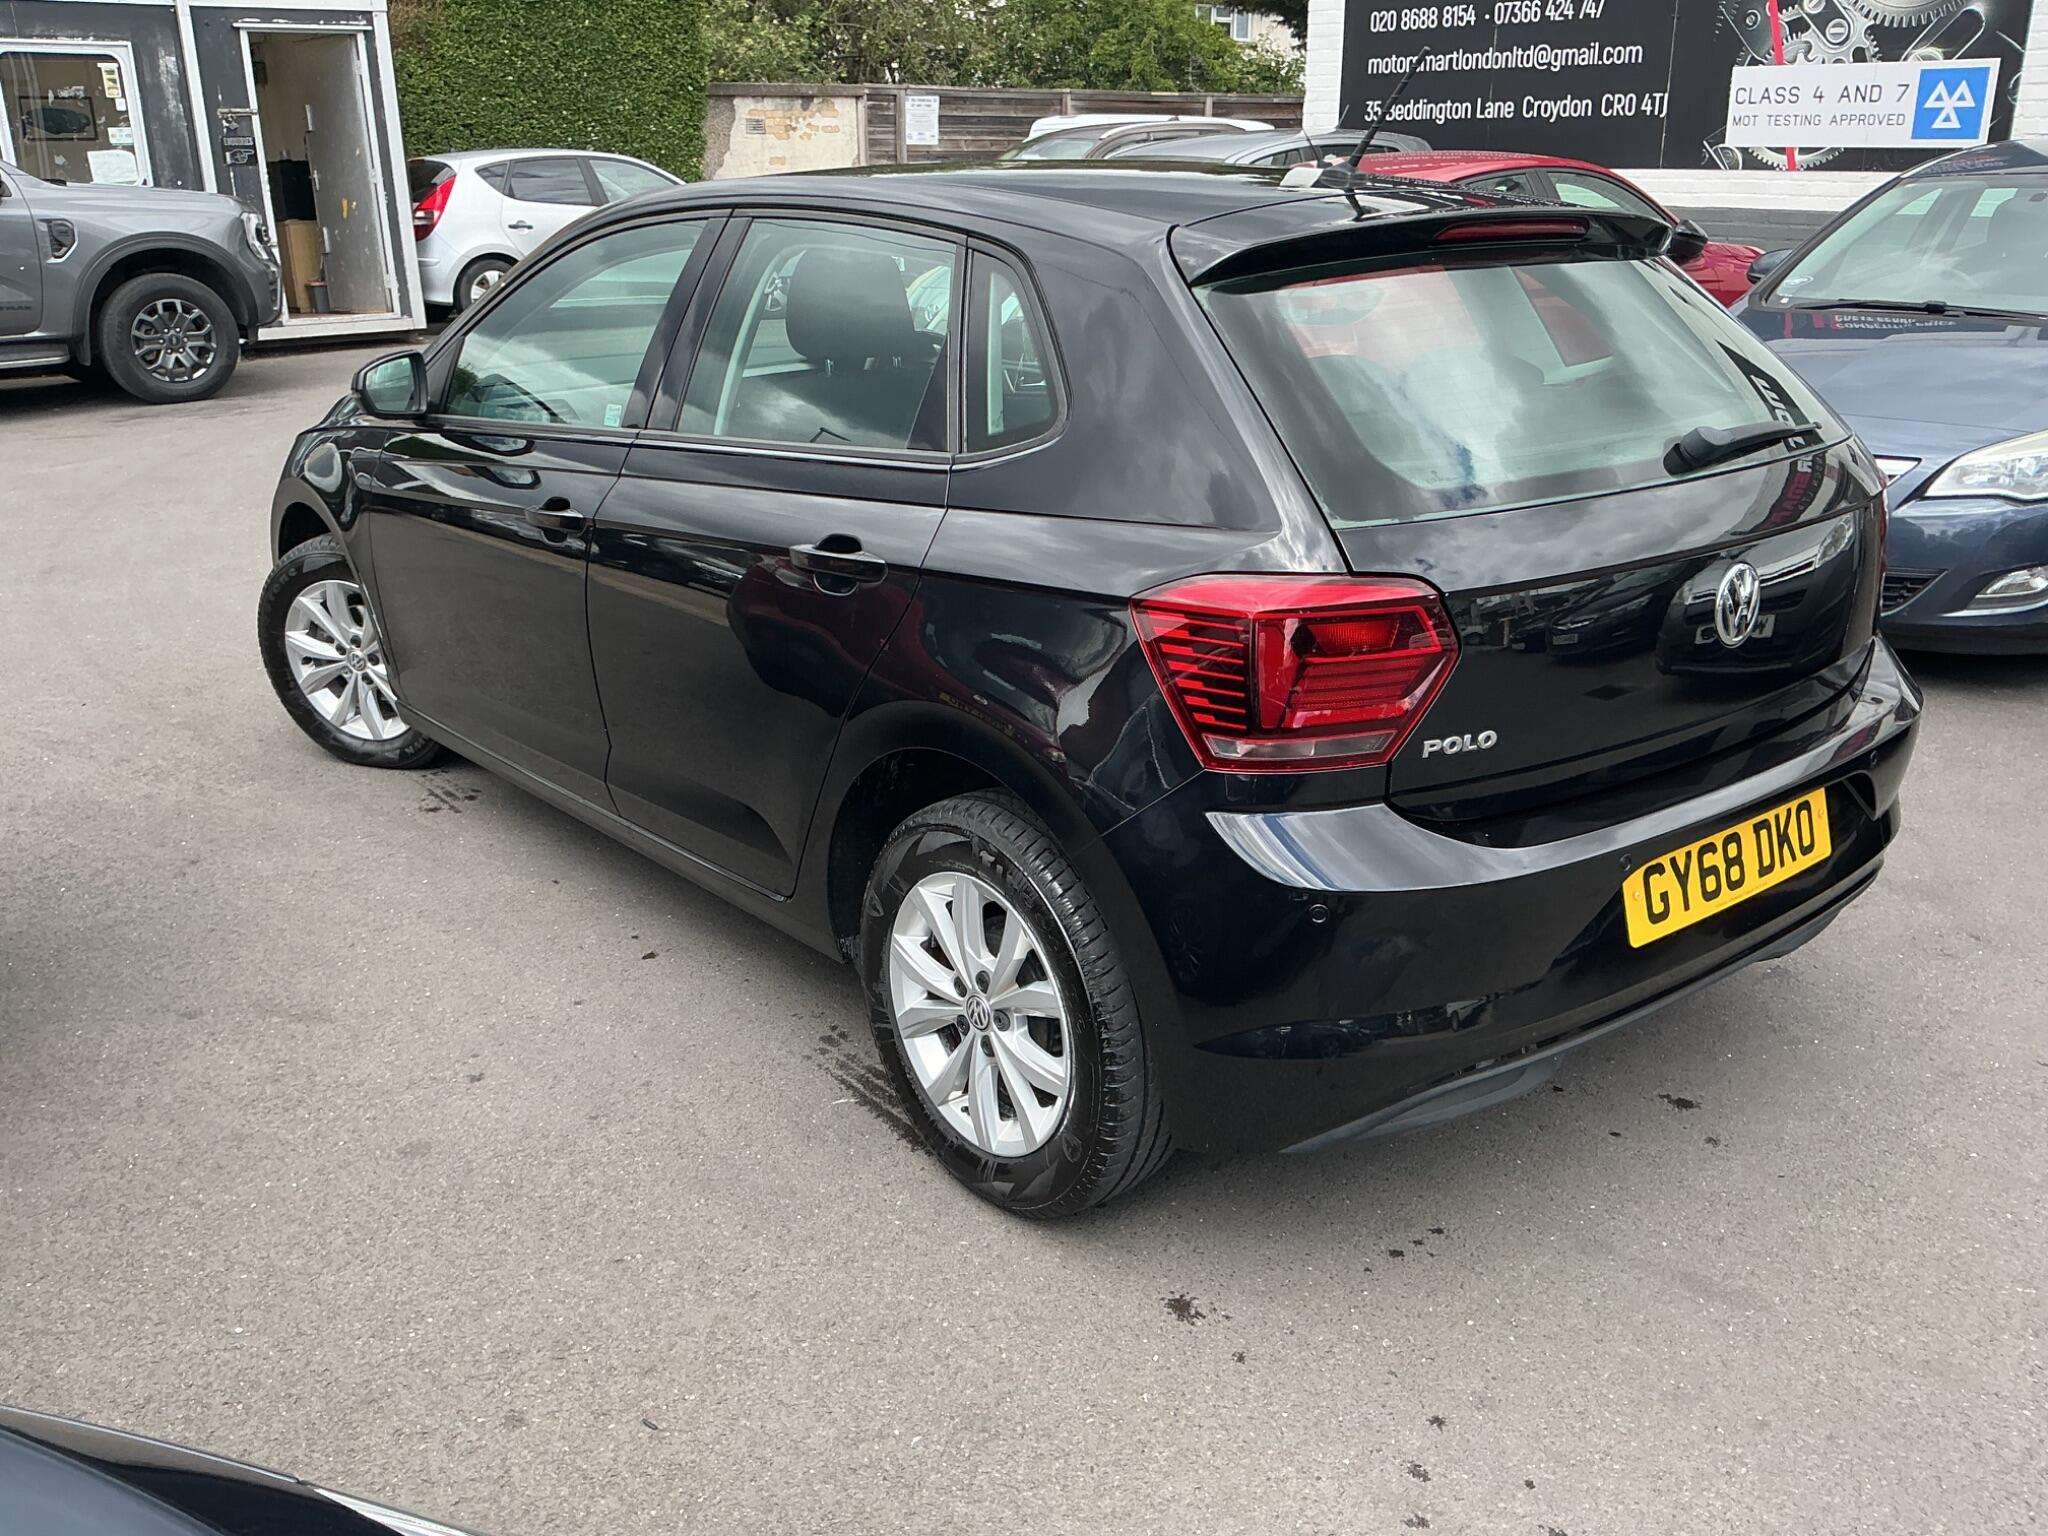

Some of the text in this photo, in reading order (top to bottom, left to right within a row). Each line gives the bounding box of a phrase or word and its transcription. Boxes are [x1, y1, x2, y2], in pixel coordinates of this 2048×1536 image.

[1370, 10, 1397, 33] 020
[1400, 7, 1438, 31] 8688
[1442, 5, 1476, 28] 8154
[1493, 0, 1542, 25] 07366
[1545, 0, 1575, 21] 424
[1364, 100, 1382, 123] 35
[1476, 98, 1514, 119] Lane
[1522, 95, 1593, 123] Croydon
[1640, 93, 1669, 118] 4TJ
[1735, 84, 1910, 105] CLASS 4 AND 7
[1732, 113, 1906, 127] MOT TESTING APPROVED
[1422, 730, 1497, 758] POLO
[1643, 799, 1815, 925] GY68 DKO
